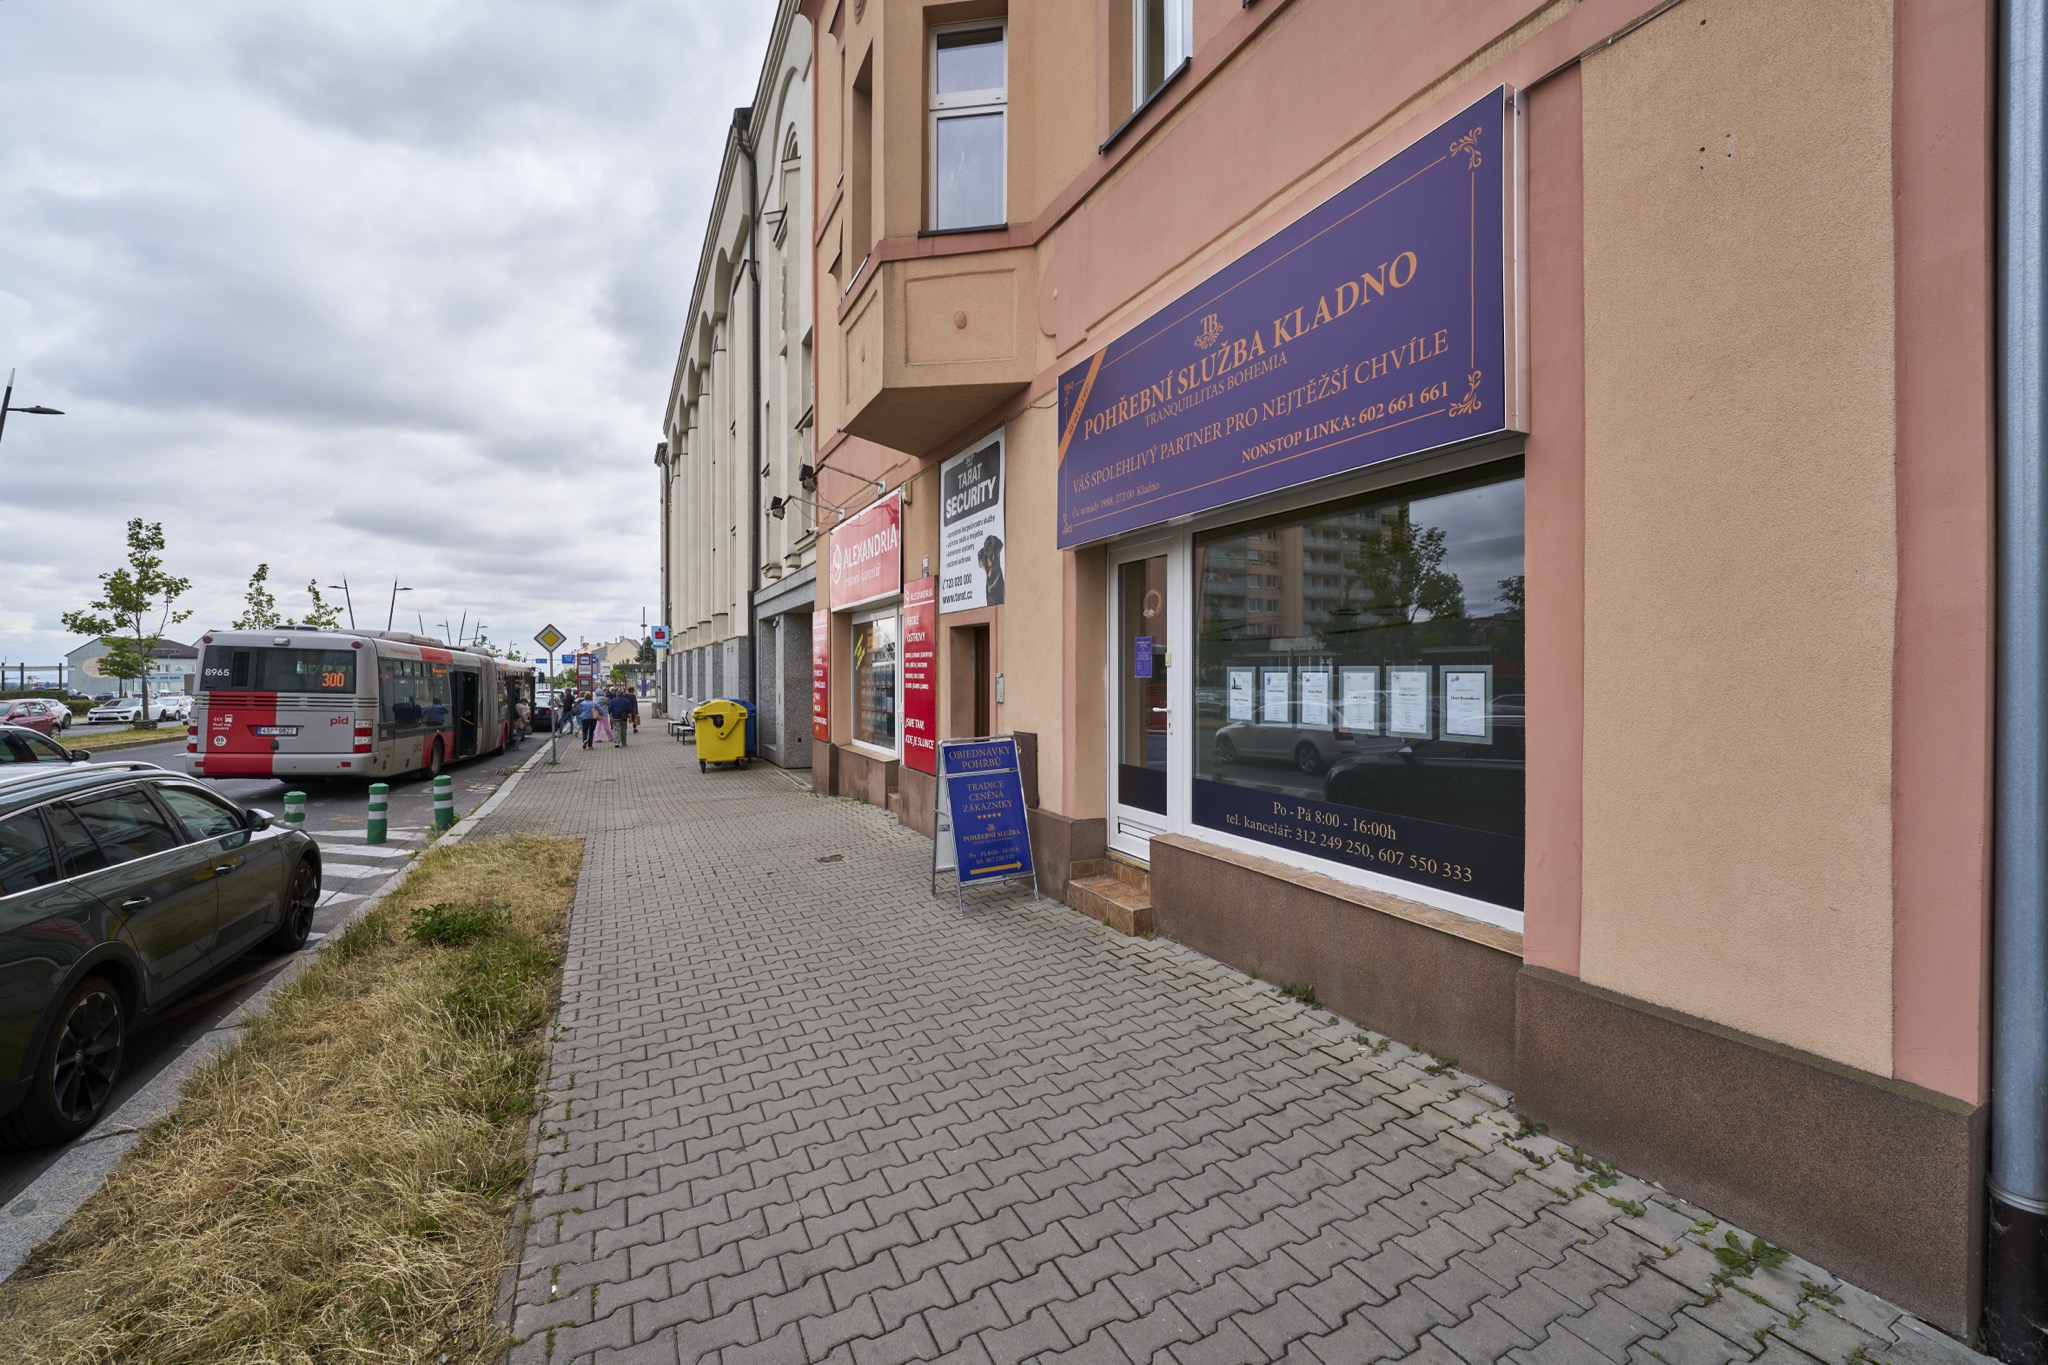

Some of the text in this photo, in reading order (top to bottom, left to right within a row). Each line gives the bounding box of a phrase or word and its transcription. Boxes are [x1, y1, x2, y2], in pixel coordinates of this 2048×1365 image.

[1084, 251, 1418, 440] POHŘEBNÍ SLUŽBA KLADNO
[1145, 352, 1288, 427] TRANQUILLITAS BOHEMIA
[1072, 329, 1449, 494] VÁŠ SPOLEHLIVÝ PARTNER PRO NEJTĚŽŠÍ CHVÍLE
[1242, 381, 1448, 463] NONSTOP LINKA: 602 661 661
[1136, 482, 1160, 496] Kladno
[946, 476, 996, 518] SECURITY
[844, 523, 897, 570] ALEXANDRIA
[942, 590, 972, 604] www.tarat.cz
[205, 668, 230, 676] 8965
[322, 673, 344, 687] 300
[330, 716, 349, 726] pid
[949, 746, 1011, 760] OBJEDNÁVKY
[962, 757, 1002, 769] POHŘBŮ
[966, 780, 1004, 791] TRADICE
[969, 790, 1004, 801] CENĚNÁ
[963, 800, 1013, 812] ZÁKAZNÍKY
[1273, 801, 1287, 816] Po
[1297, 806, 1312, 822] Pá
[1315, 810, 1340, 828] 8:00
[1352, 818, 1397, 841] 16:00h
[1226, 813, 1472, 883] tel. kancelář: 312 249 250, 607 550 333
